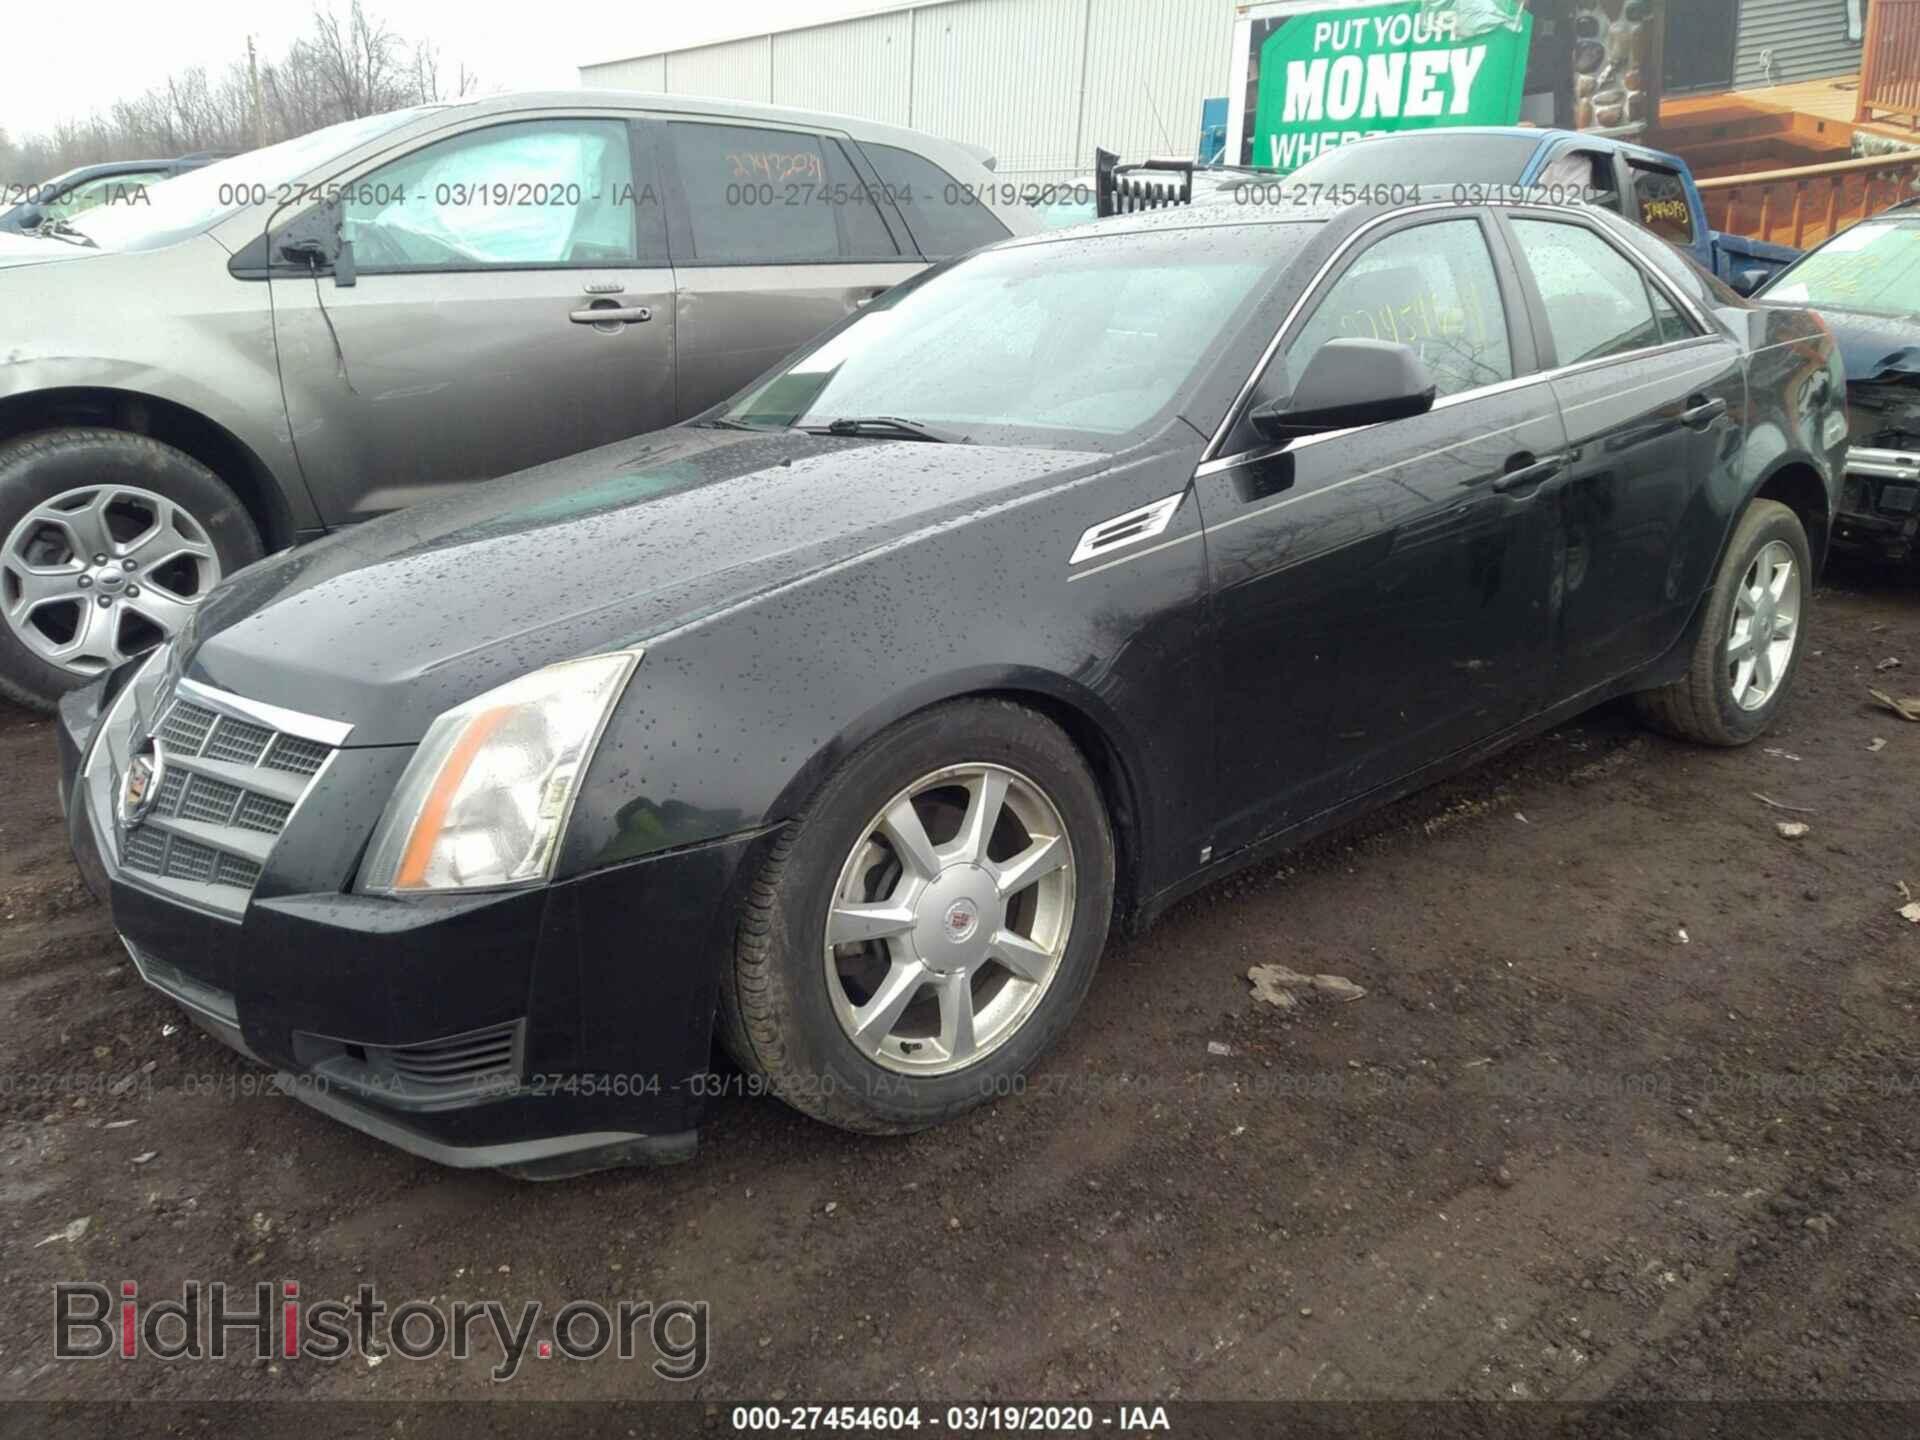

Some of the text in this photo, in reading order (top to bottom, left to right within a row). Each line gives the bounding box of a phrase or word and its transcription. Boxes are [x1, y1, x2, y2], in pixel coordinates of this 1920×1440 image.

[1314, 10, 1457, 52] PUT YOUR
[1282, 45, 1487, 122] MONEY
